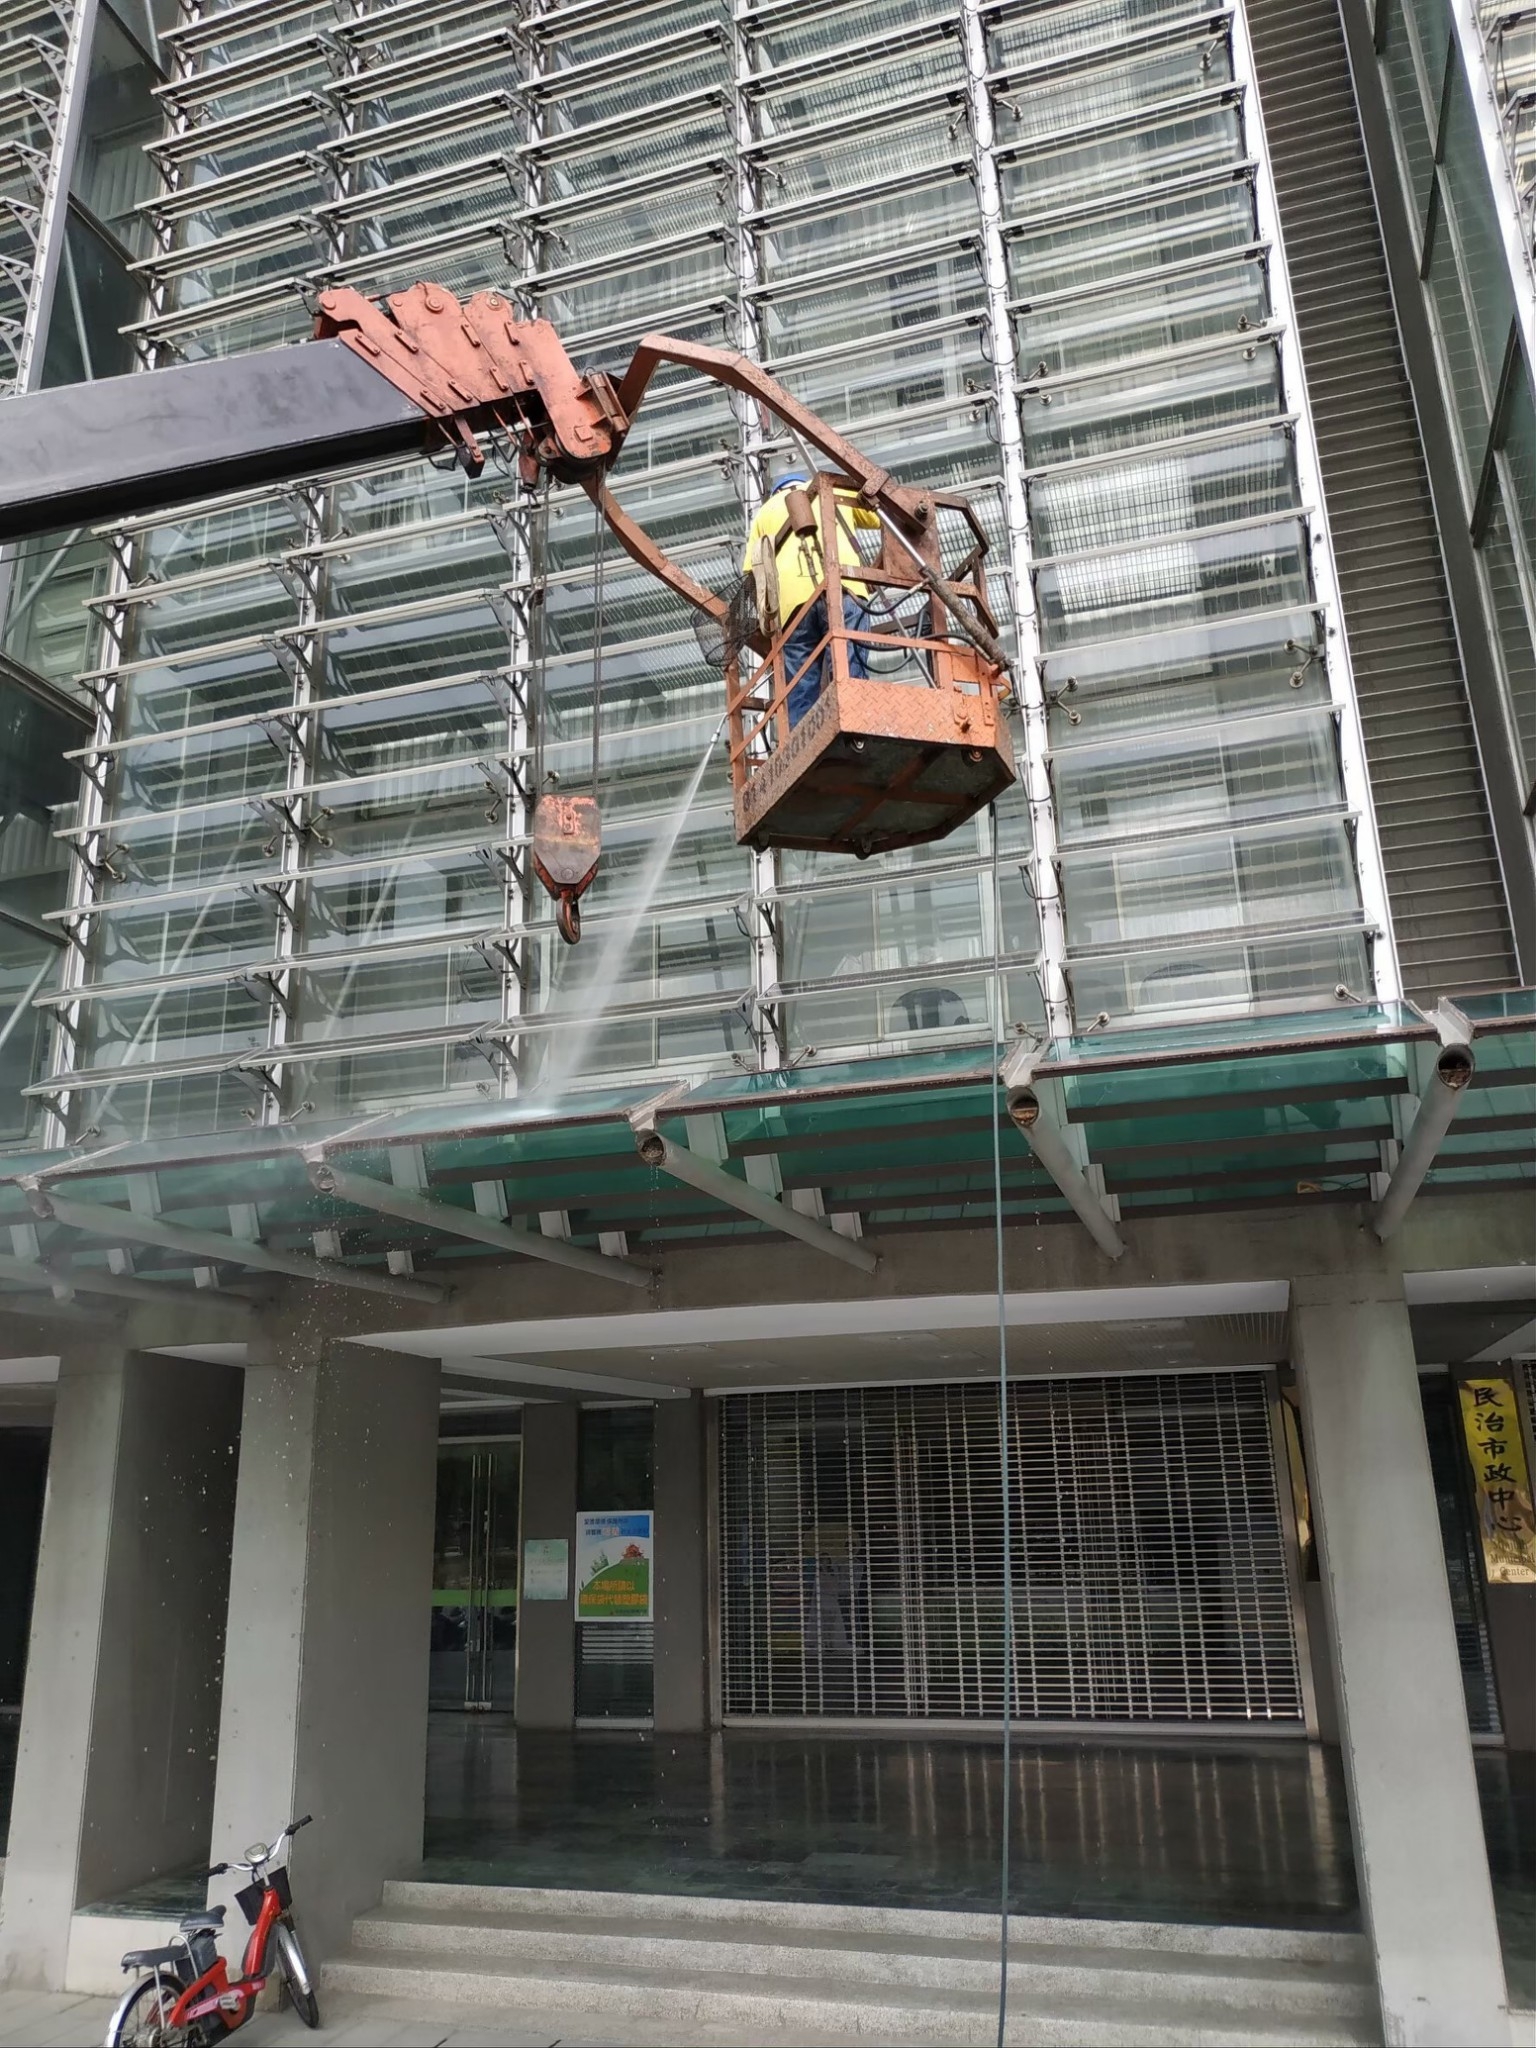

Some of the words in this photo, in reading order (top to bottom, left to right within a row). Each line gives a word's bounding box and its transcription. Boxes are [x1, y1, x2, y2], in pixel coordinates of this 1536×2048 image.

[1473, 1387, 1523, 1532] 民治市政中心
[1490, 1552, 1536, 1565] Municipal
[1499, 1566, 1530, 1576] Center
